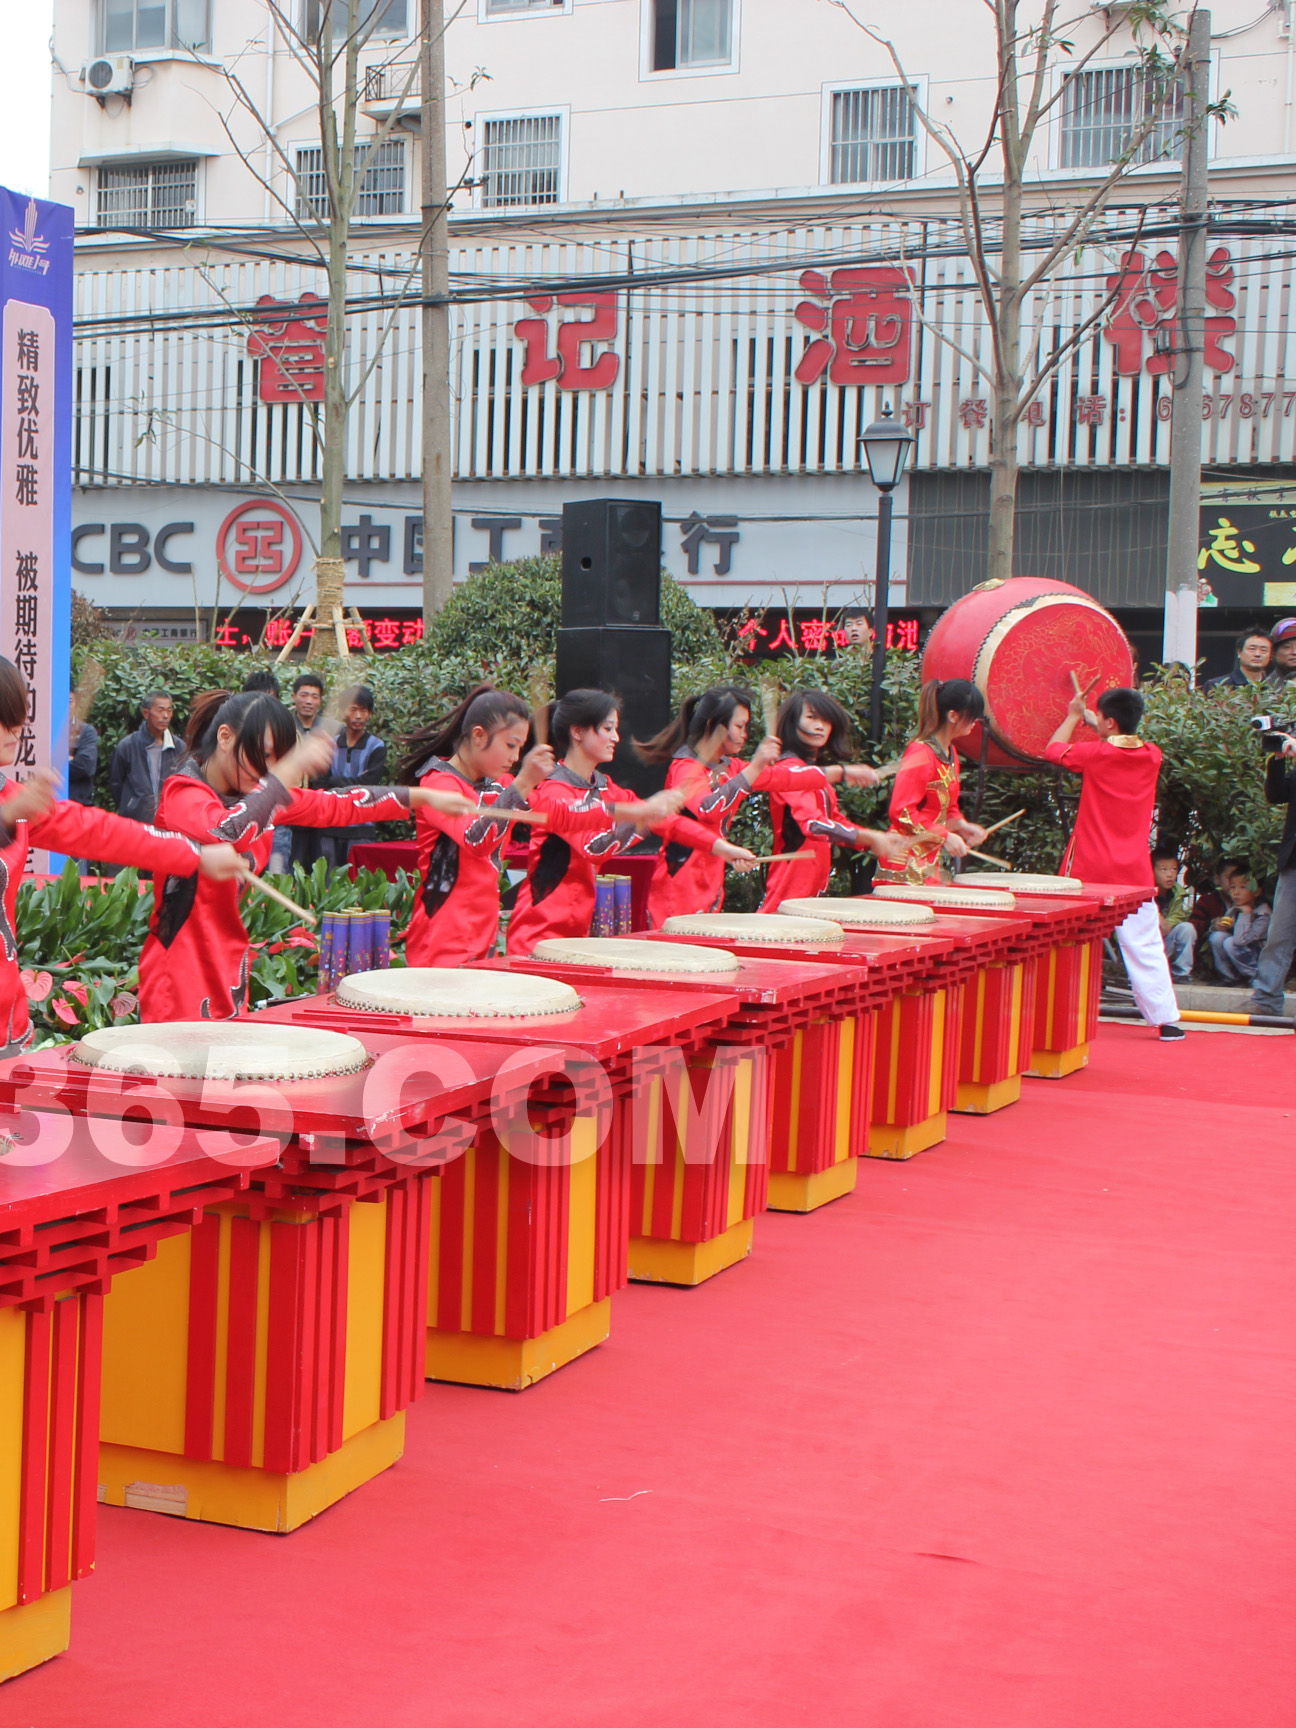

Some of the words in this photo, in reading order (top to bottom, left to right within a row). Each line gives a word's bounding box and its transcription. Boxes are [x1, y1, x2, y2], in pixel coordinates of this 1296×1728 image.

[16, 327, 40, 506] 精致优雅
[14, 550, 39, 783] 被期待龙
